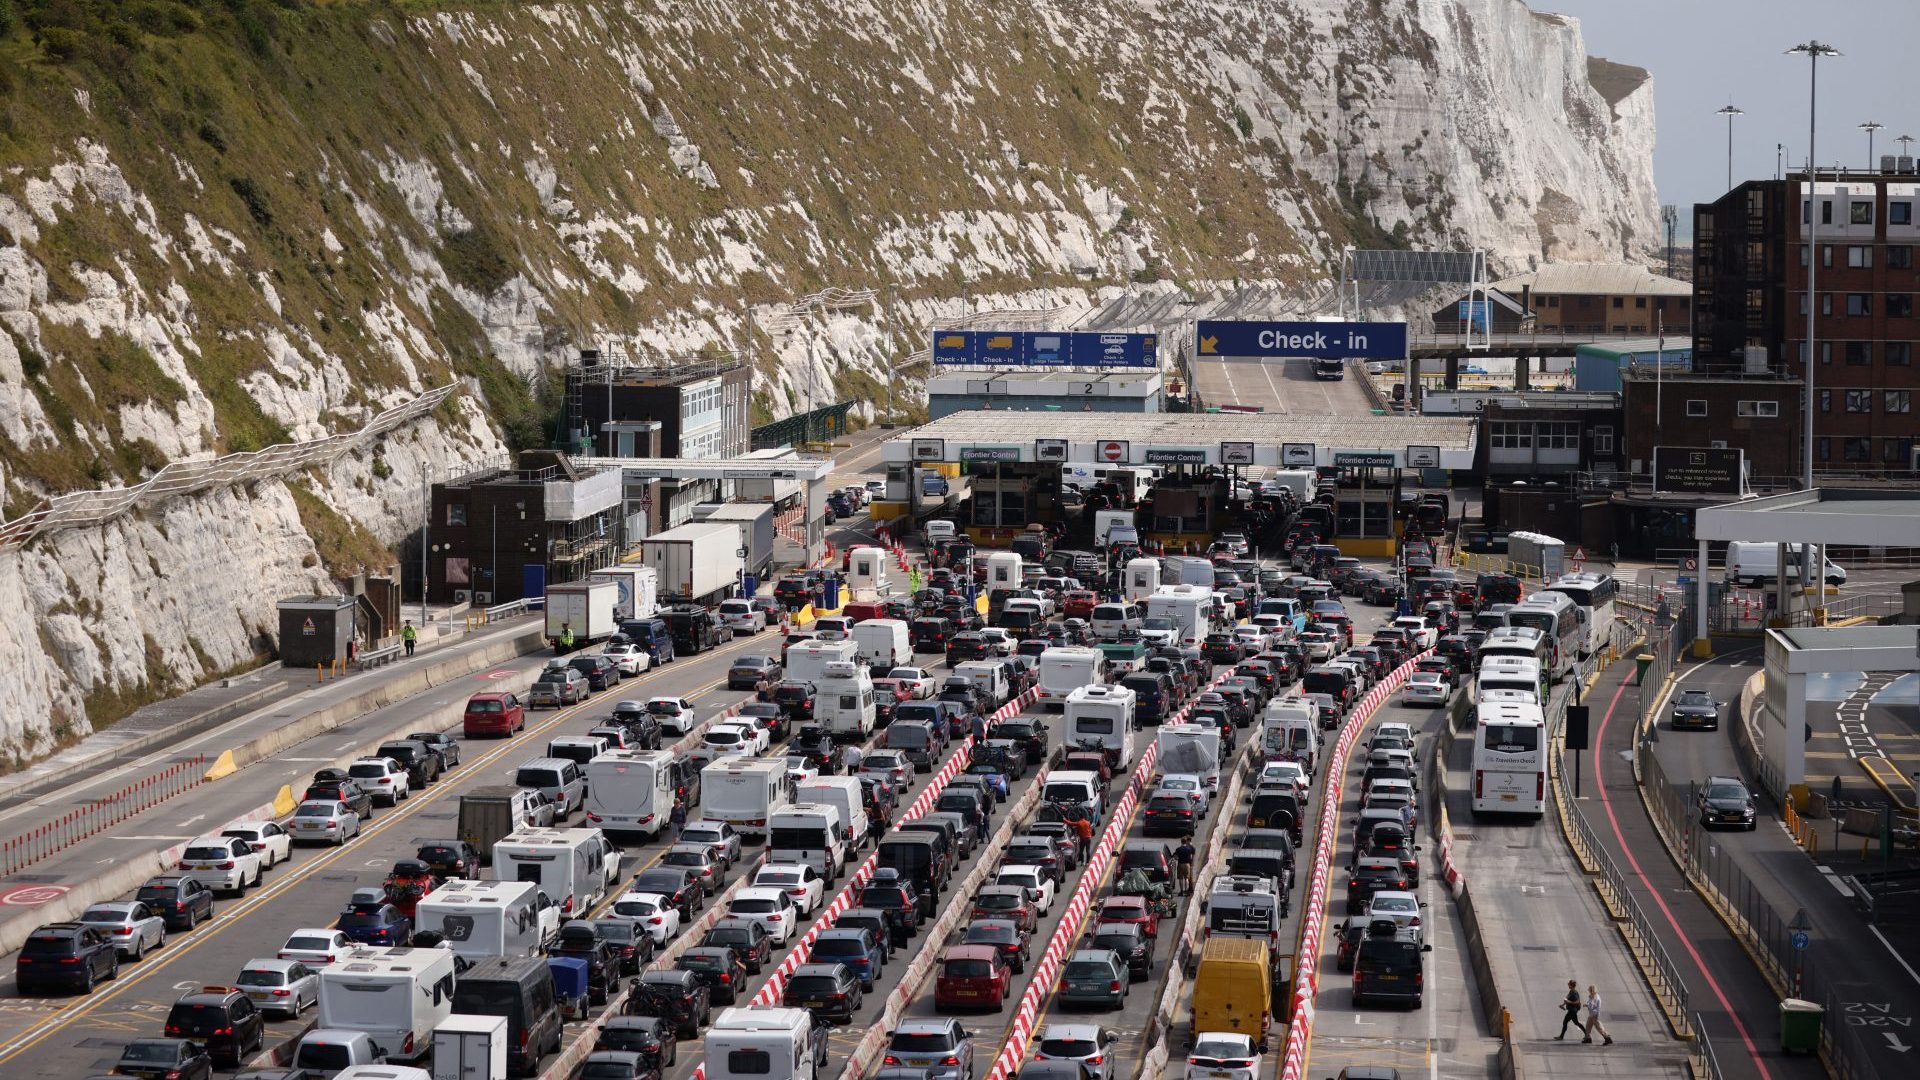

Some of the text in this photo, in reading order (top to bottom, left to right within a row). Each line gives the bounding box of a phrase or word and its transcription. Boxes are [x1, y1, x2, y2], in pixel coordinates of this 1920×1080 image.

[1258, 330, 1327, 349] Check
[1349, 331, 1368, 349] in
[984, 382, 991, 393] 1
[1084, 383, 1093, 394] 2
[1475, 399, 1483, 411] 3
[963, 451, 1017, 459] Frontier Control
[1148, 453, 1176, 461] Frontier
[1337, 457, 1393, 465] Frontier Control
